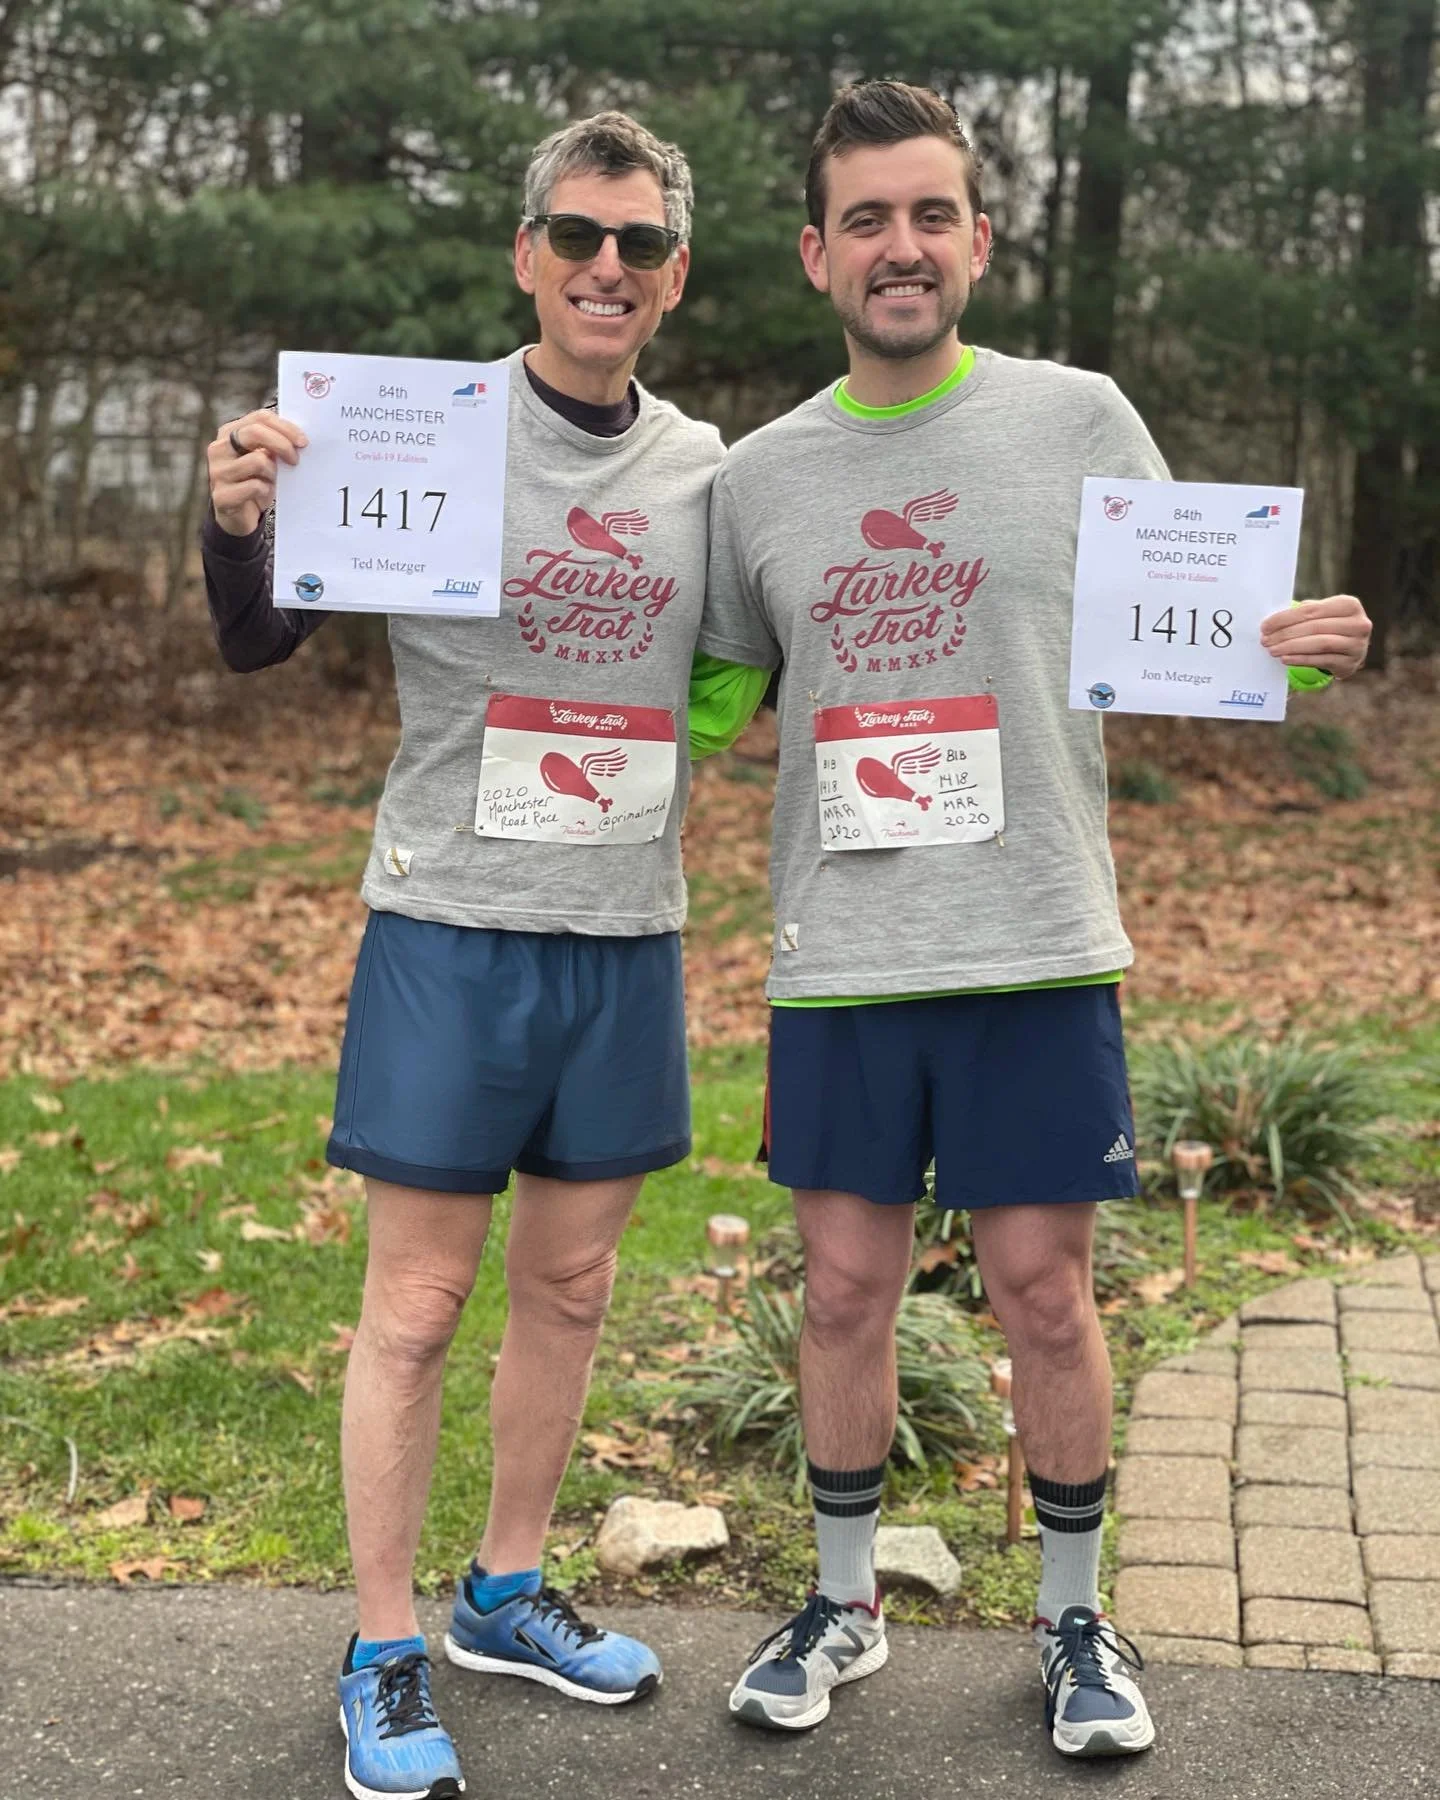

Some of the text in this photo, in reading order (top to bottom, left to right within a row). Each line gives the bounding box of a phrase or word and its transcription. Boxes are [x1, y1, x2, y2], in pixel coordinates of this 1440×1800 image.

[379, 385, 408, 399] 84th
[341, 406, 445, 424] MANCHESTER
[348, 429, 437, 446] ROAD RACE
[355, 451, 429, 463] Covid-19 Edition
[337, 485, 448, 532] 1417
[1173, 508, 1202, 521] 84th
[1135, 527, 1238, 545] MANCHESTER
[351, 557, 427, 574] Ted Metzger
[1142, 550, 1228, 567] ROAD RACE
[503, 549, 680, 618] Turkey
[1147, 570, 1219, 582] Covid-19 Edition
[810, 557, 991, 623] Turkey
[544, 601, 637, 640] Trot
[851, 601, 945, 649] Trot
[1129, 603, 1233, 649] 1418
[1141, 669, 1213, 686] Jon Metzger
[552, 709, 625, 728] Turkey Trot
[859, 711, 901, 727] Turkey
[903, 709, 930, 722] Trot
[823, 759, 836, 769] BIB
[946, 749, 967, 762] BIB
[939, 772, 968, 788] 1418
[483, 786, 528, 801] 2020
[489, 796, 554, 822] Manchester
[824, 803, 856, 821] MRR
[944, 797, 979, 811] MRR
[501, 811, 559, 832] Road Race
[944, 812, 990, 827] 2020
[828, 824, 861, 840] 2020
